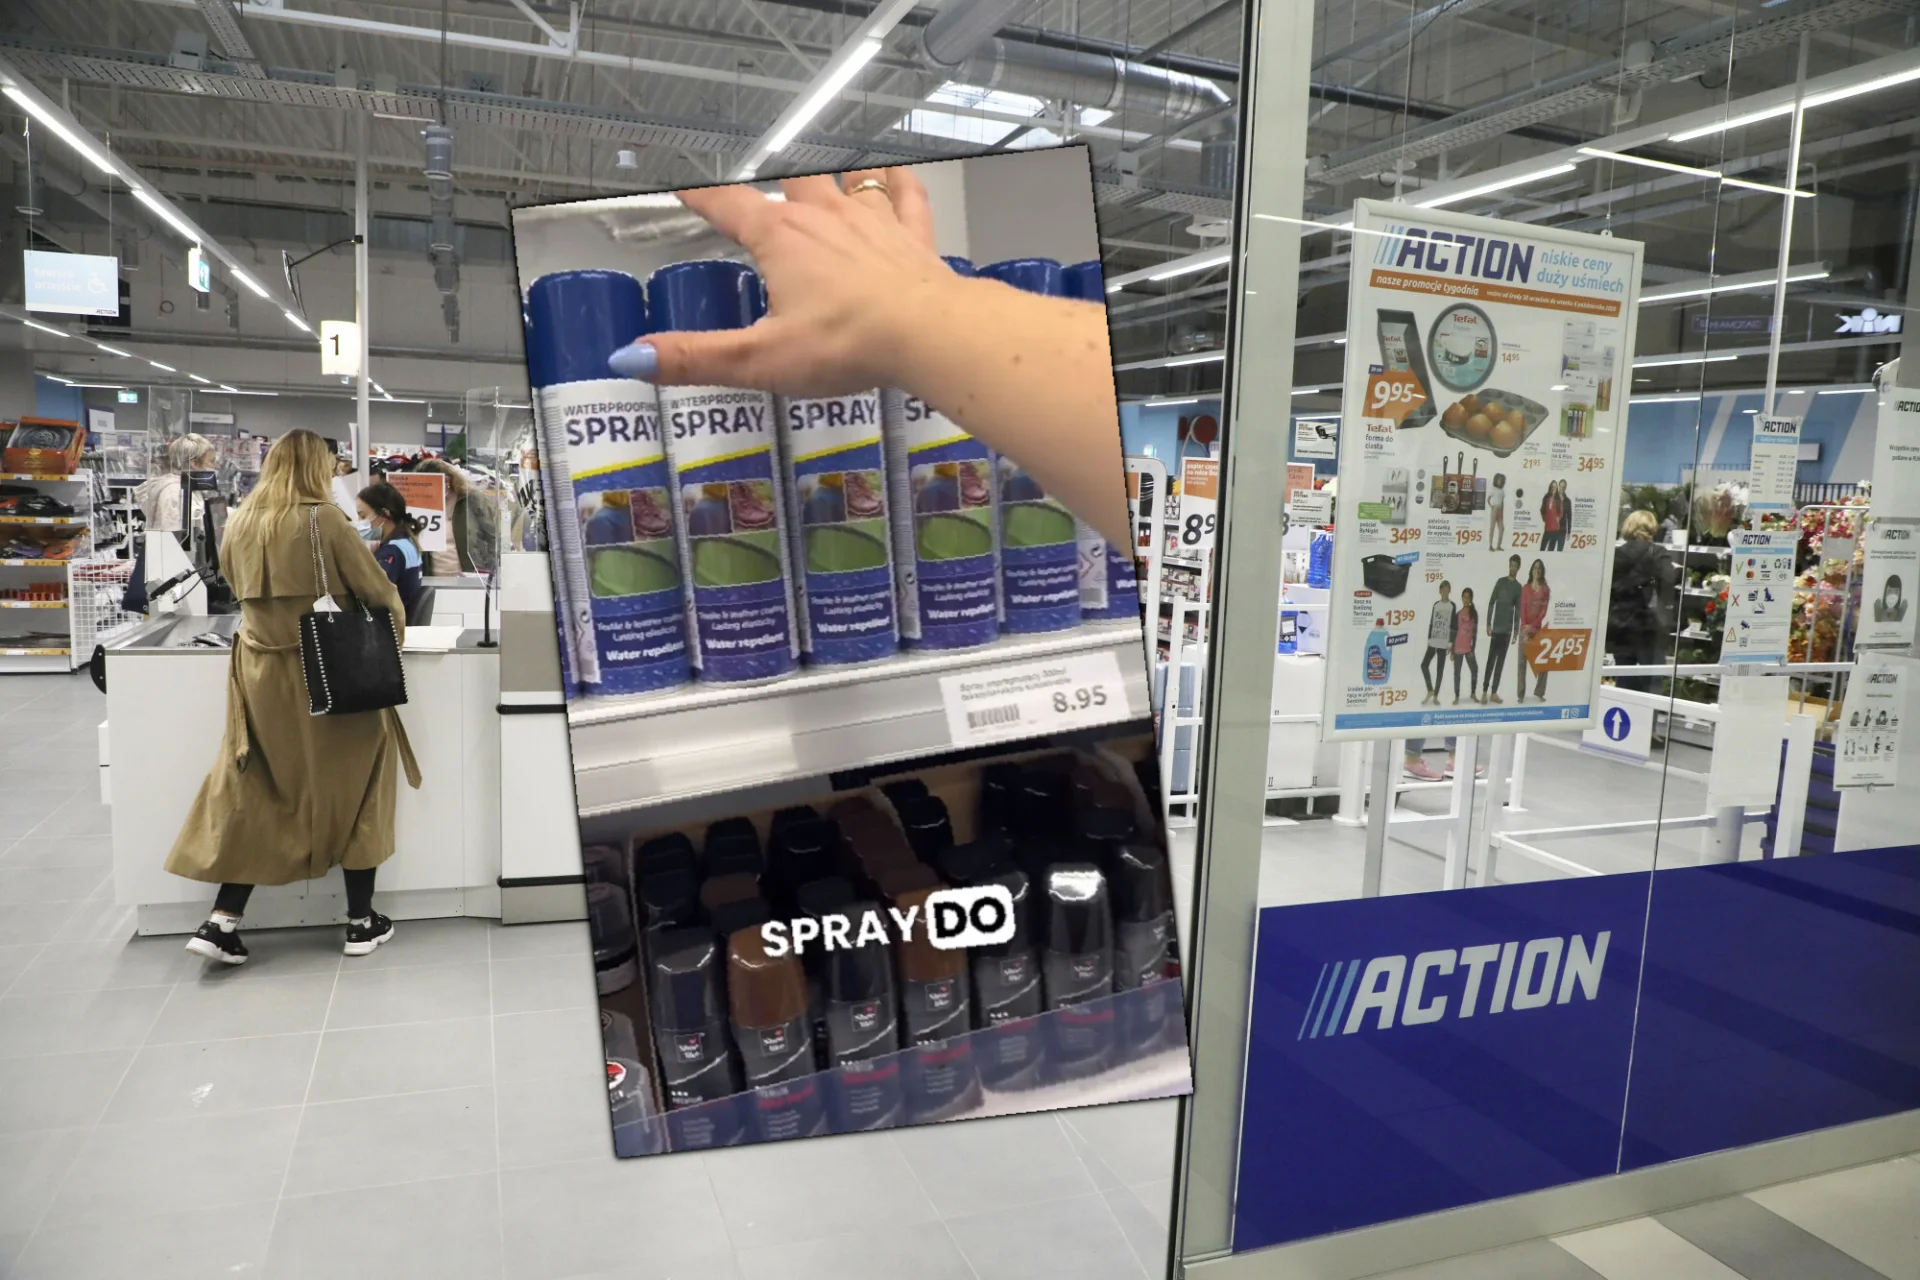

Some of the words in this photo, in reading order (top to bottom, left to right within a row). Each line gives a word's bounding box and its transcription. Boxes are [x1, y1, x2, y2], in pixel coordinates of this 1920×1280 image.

[1396, 228, 1535, 284] ACTION
[1540, 249, 1579, 268] niskie
[1582, 257, 1612, 274] ceny
[1376, 276, 1401, 286] nasze
[1402, 278, 1442, 292] promocje
[1443, 284, 1479, 296] tygodnia
[1537, 268, 1568, 288] duży
[1572, 274, 1623, 294] uśmiech
[1453, 314, 1477, 325] Tefal
[330, 334, 339, 356] 1
[671, 405, 765, 439] SPRAY
[789, 399, 877, 430] SPRAY
[566, 414, 659, 446] SPRAY
[1366, 424, 1392, 433] Tefal
[1763, 421, 1797, 433] ACTION
[1365, 434, 1384, 443] forma
[1385, 434, 1394, 442] do
[1365, 442, 1383, 450] ciasta
[1577, 456, 1605, 472] 3495
[1390, 527, 1421, 544] 3499
[1456, 530, 1482, 545] 1995
[1511, 532, 1541, 548] 2247
[1570, 534, 1598, 549] 2695
[1742, 534, 1771, 545] ACTION
[1425, 572, 1443, 583] 1995
[1010, 594, 1042, 603] Water
[927, 609, 959, 619] Water
[1385, 610, 1415, 626] 1399
[816, 622, 848, 633] Water
[705, 638, 737, 649] Water
[738, 632, 784, 648] repellent
[606, 650, 641, 661] Water
[643, 640, 684, 657] repellent
[1535, 638, 1585, 664] 2495
[1870, 673, 1898, 684] ACTION
[1052, 684, 1107, 713] 8.95
[1380, 689, 1408, 706] 1329
[1343, 931, 1611, 1035] ACTION
